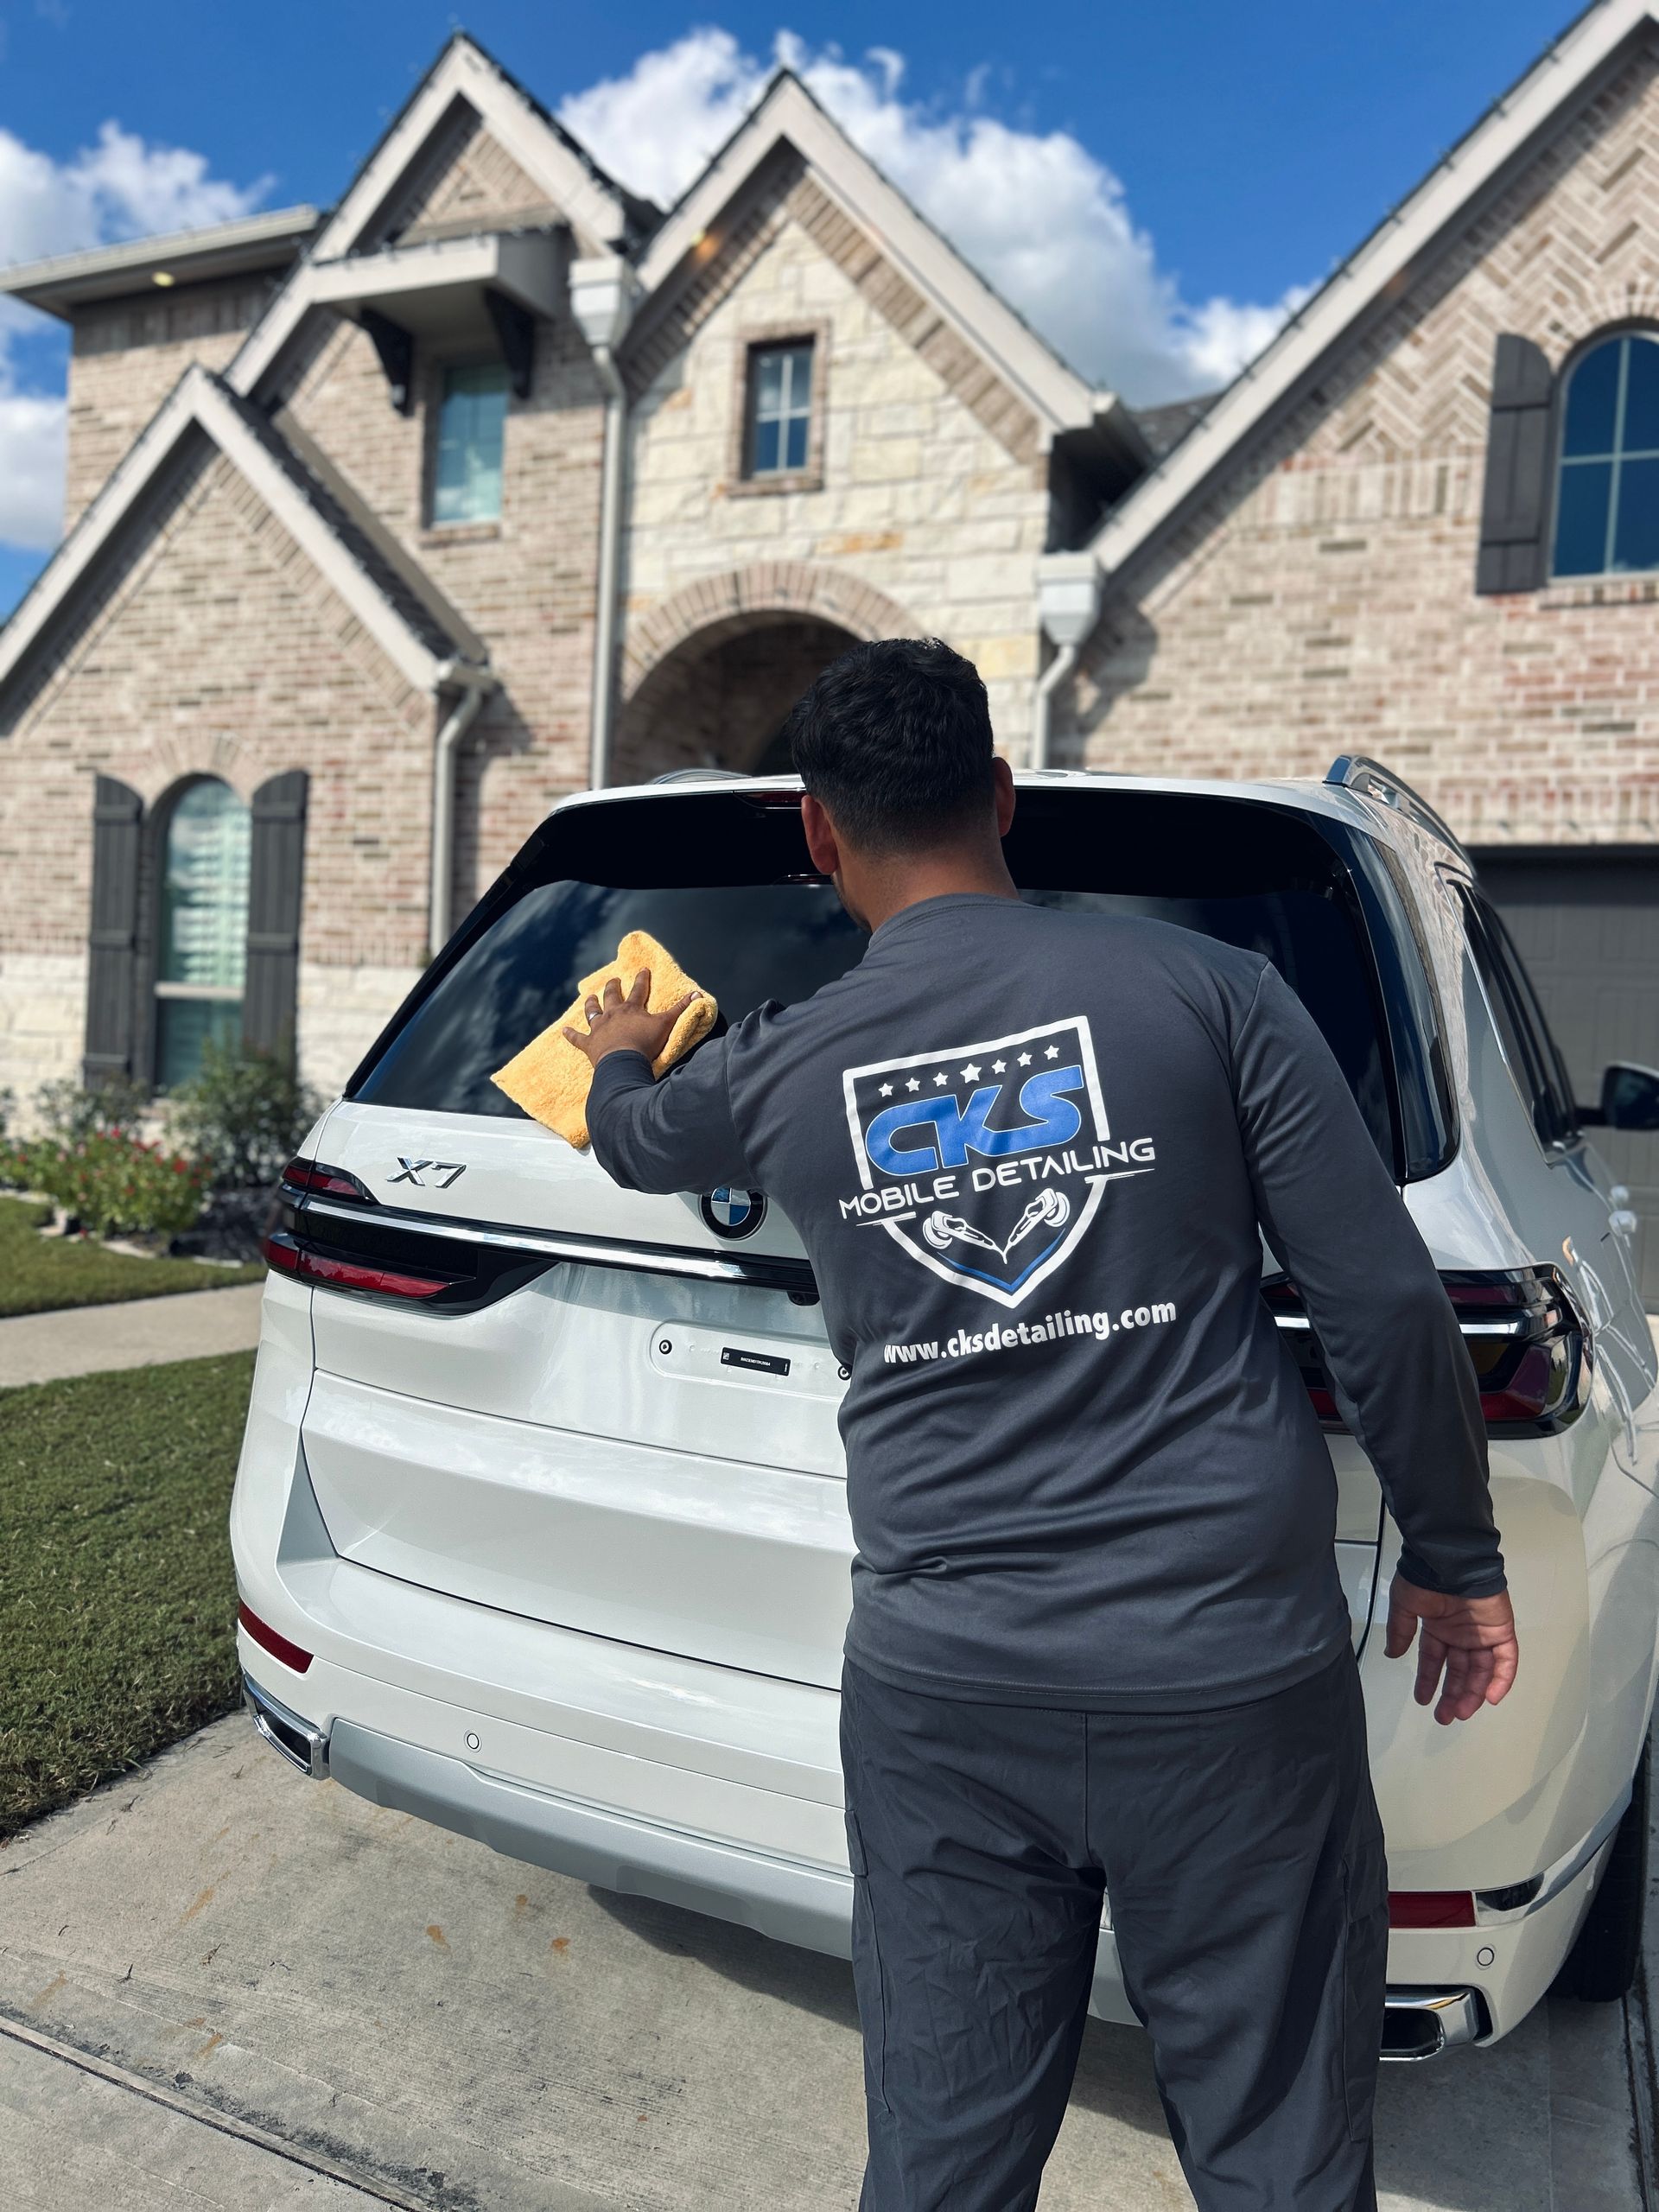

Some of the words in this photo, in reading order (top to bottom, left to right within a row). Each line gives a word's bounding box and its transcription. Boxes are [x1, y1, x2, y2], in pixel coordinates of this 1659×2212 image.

[866, 1065, 1084, 1176] CKS
[385, 1155, 467, 1189] X7
[838, 1175, 960, 1219] MOBILE
[971, 1137, 1156, 1192] DETAILING
[883, 1302, 1176, 1363] www.cksdetailing.com
